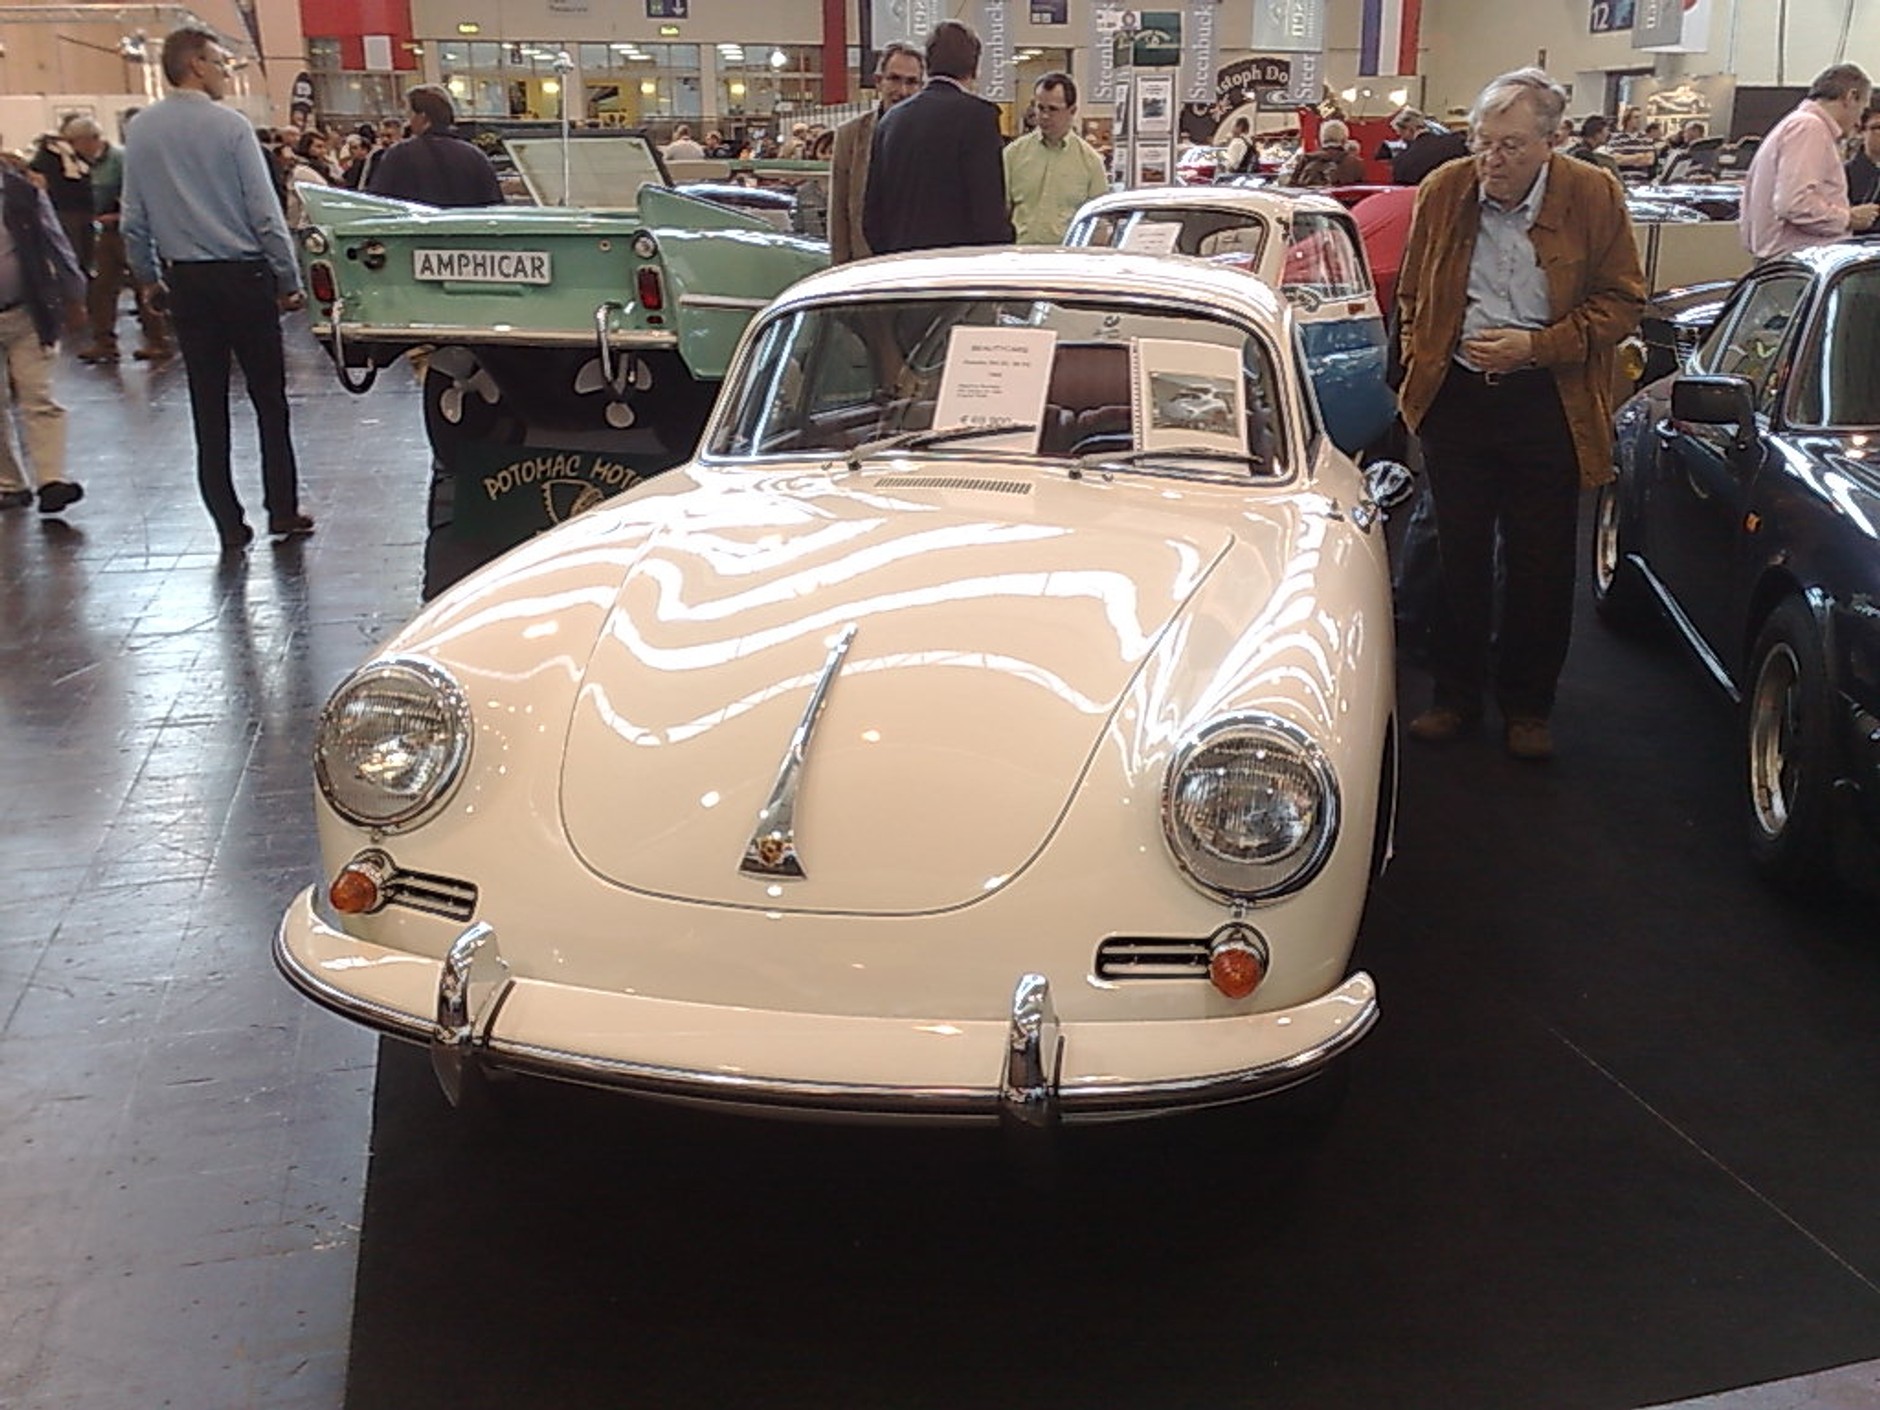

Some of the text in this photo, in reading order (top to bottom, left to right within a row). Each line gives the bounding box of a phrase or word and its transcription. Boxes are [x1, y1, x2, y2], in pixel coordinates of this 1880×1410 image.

[1593, 2, 1609, 30] 12
[1188, 4, 1213, 99] Steenbuck
[420, 253, 545, 279] AMPHICAR
[484, 455, 581, 500] POTOMAC
